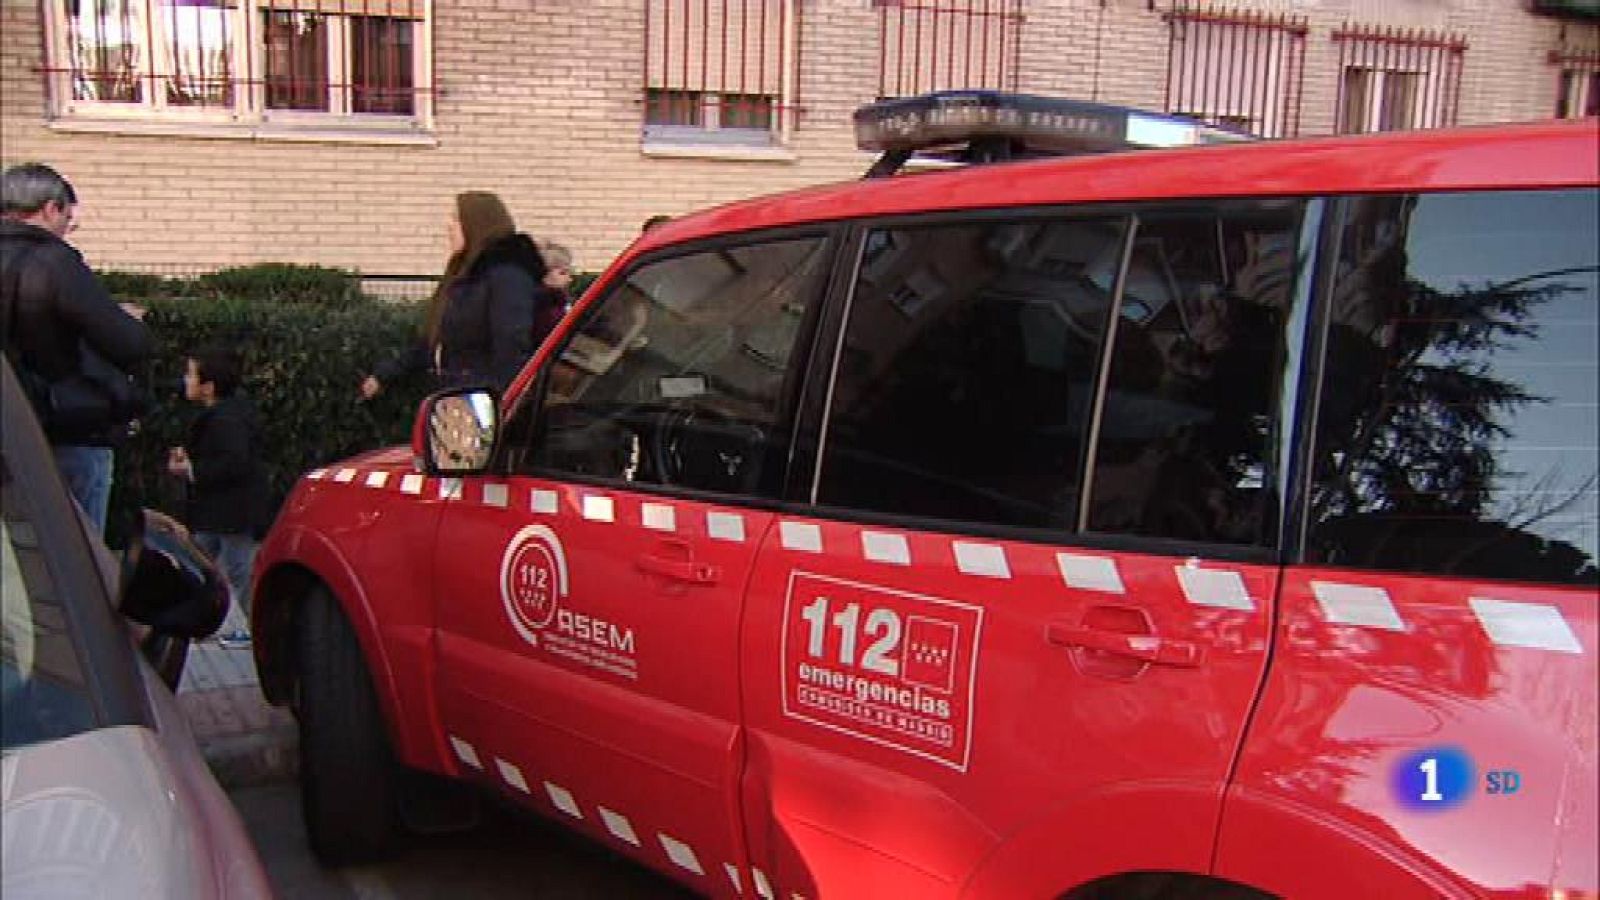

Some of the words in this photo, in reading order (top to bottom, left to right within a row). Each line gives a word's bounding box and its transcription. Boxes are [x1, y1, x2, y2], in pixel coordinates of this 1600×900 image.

[519, 565, 548, 588] 112
[557, 609, 635, 654] ASEM
[802, 597, 901, 675] 112
[799, 662, 950, 719] emergencias
